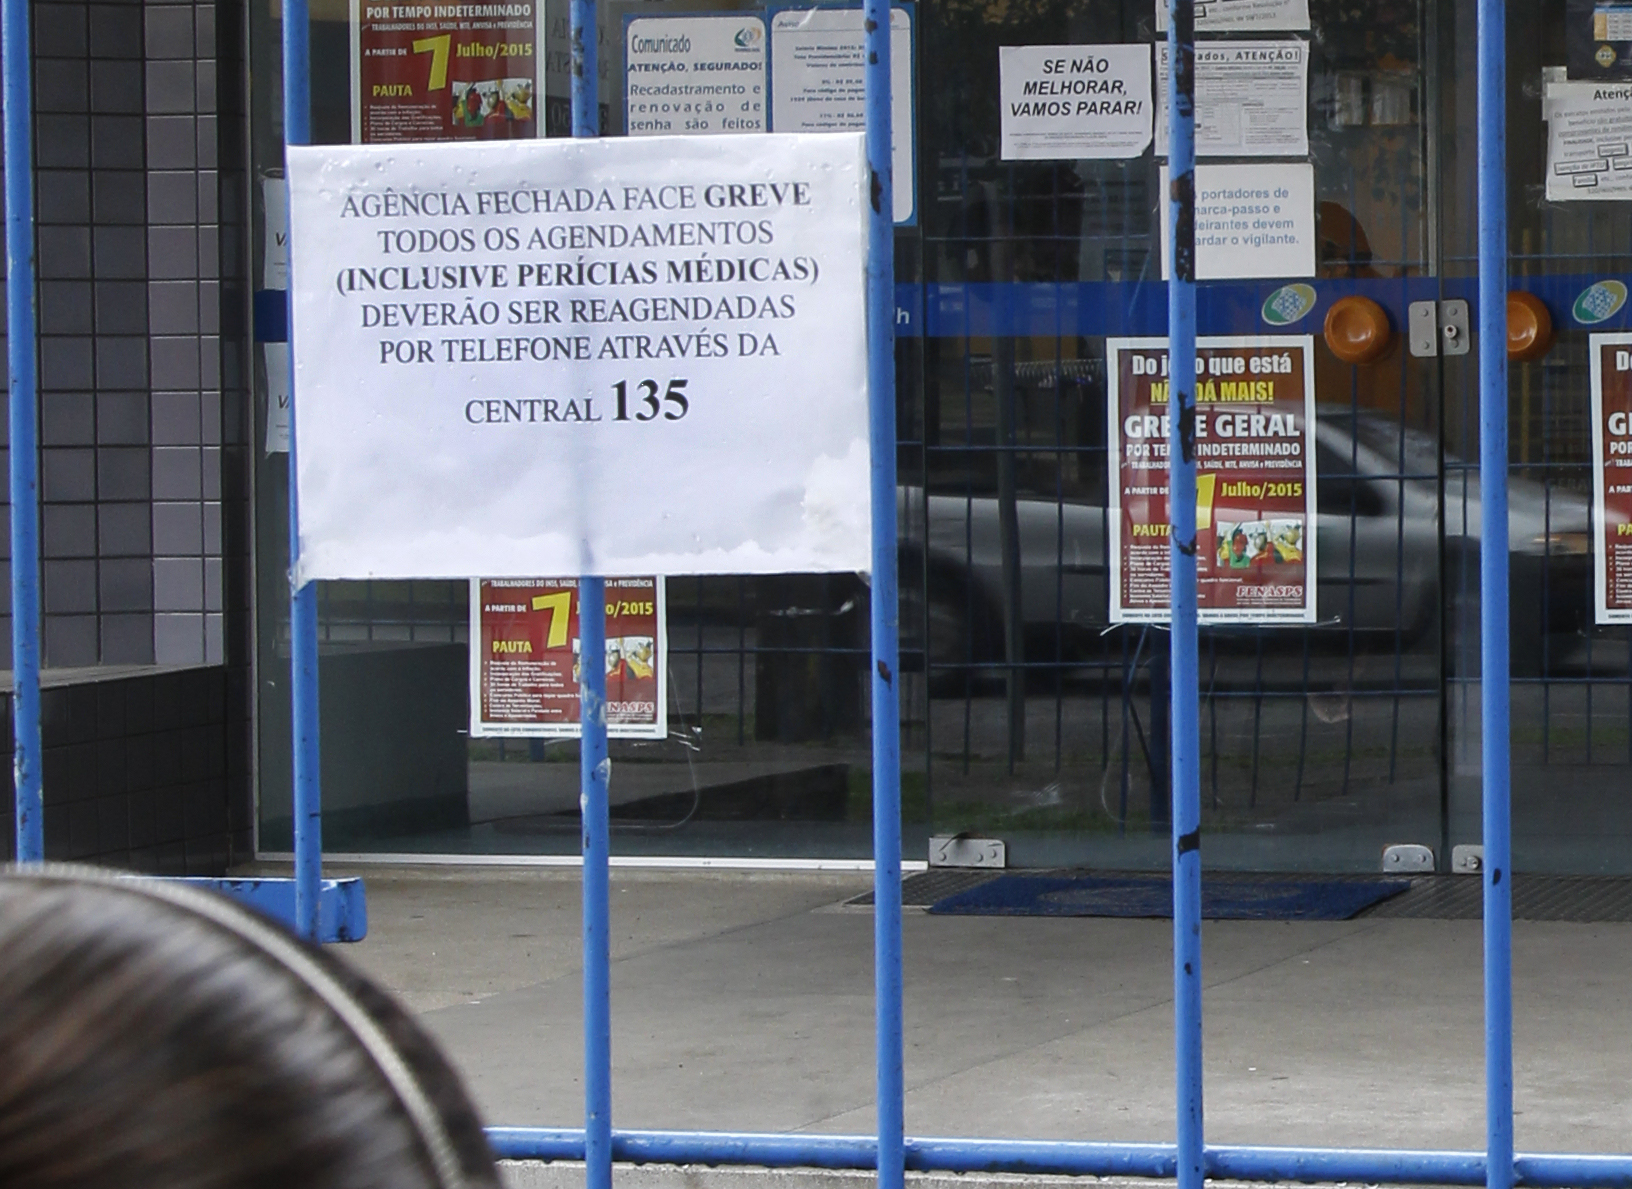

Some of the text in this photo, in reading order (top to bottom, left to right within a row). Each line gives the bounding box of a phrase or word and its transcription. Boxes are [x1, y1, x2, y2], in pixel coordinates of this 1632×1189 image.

[366, 4, 531, 19] POR TEMPO INDETERMINADO
[456, 42, 533, 60] Julho/2015
[631, 34, 691, 54] Comunicado
[372, 48, 396, 56] PARTIR
[398, 48, 407, 56] DE
[1235, 49, 1298, 63] ATENÇÃO!
[412, 34, 451, 91] 7
[628, 61, 762, 74] ATENÇÃO, SEGURADO!
[1043, 55, 1109, 74] SE NÃO
[373, 84, 412, 97] PAUTA
[630, 84, 761, 96] Recadastramento e
[1023, 80, 1127, 96] MELHORAR,
[630, 100, 761, 114] renovação de
[1011, 101, 1142, 116] VAMOS PARAR!
[630, 117, 761, 131] senha são feitos
[340, 181, 812, 218] AGÊNCIA FECHADA FACE GREVE
[1202, 187, 1289, 201] portadores de
[1273, 206, 1280, 214] e
[1252, 218, 1294, 229] devem
[377, 219, 774, 254] TODOS OS AGENDAMENTOS
[1231, 236, 1239, 245] o
[1243, 233, 1299, 247] vigilante.
[336, 251, 820, 297] (INCLUSIVE PERÍCIAS MÉDICAS)
[361, 294, 797, 328] DEVERÃO SER REAGENDADAS
[379, 326, 781, 364] POR TELEFONE ATRAVÉS DA
[1132, 355, 1157, 375] Do
[1208, 356, 1246, 377] que
[1249, 352, 1292, 374] está
[1220, 380, 1275, 402] MAIS!
[465, 378, 690, 424] CENTRAL 135
[1124, 413, 1300, 438] GREE GERAL
[1126, 444, 1151, 457] POR
[1197, 442, 1300, 456] INDETERMINADO
[1124, 487, 1131, 495] A
[1132, 486, 1158, 495] PARTIR
[1221, 481, 1303, 500] Julho/2015
[1608, 486, 1616, 494] A
[1236, 585, 1303, 598] FENASPS
[485, 604, 527, 612] A PARTIR DE
[531, 591, 571, 648] 7
[492, 640, 533, 653] PAUTA
[606, 701, 654, 712] NASPS
